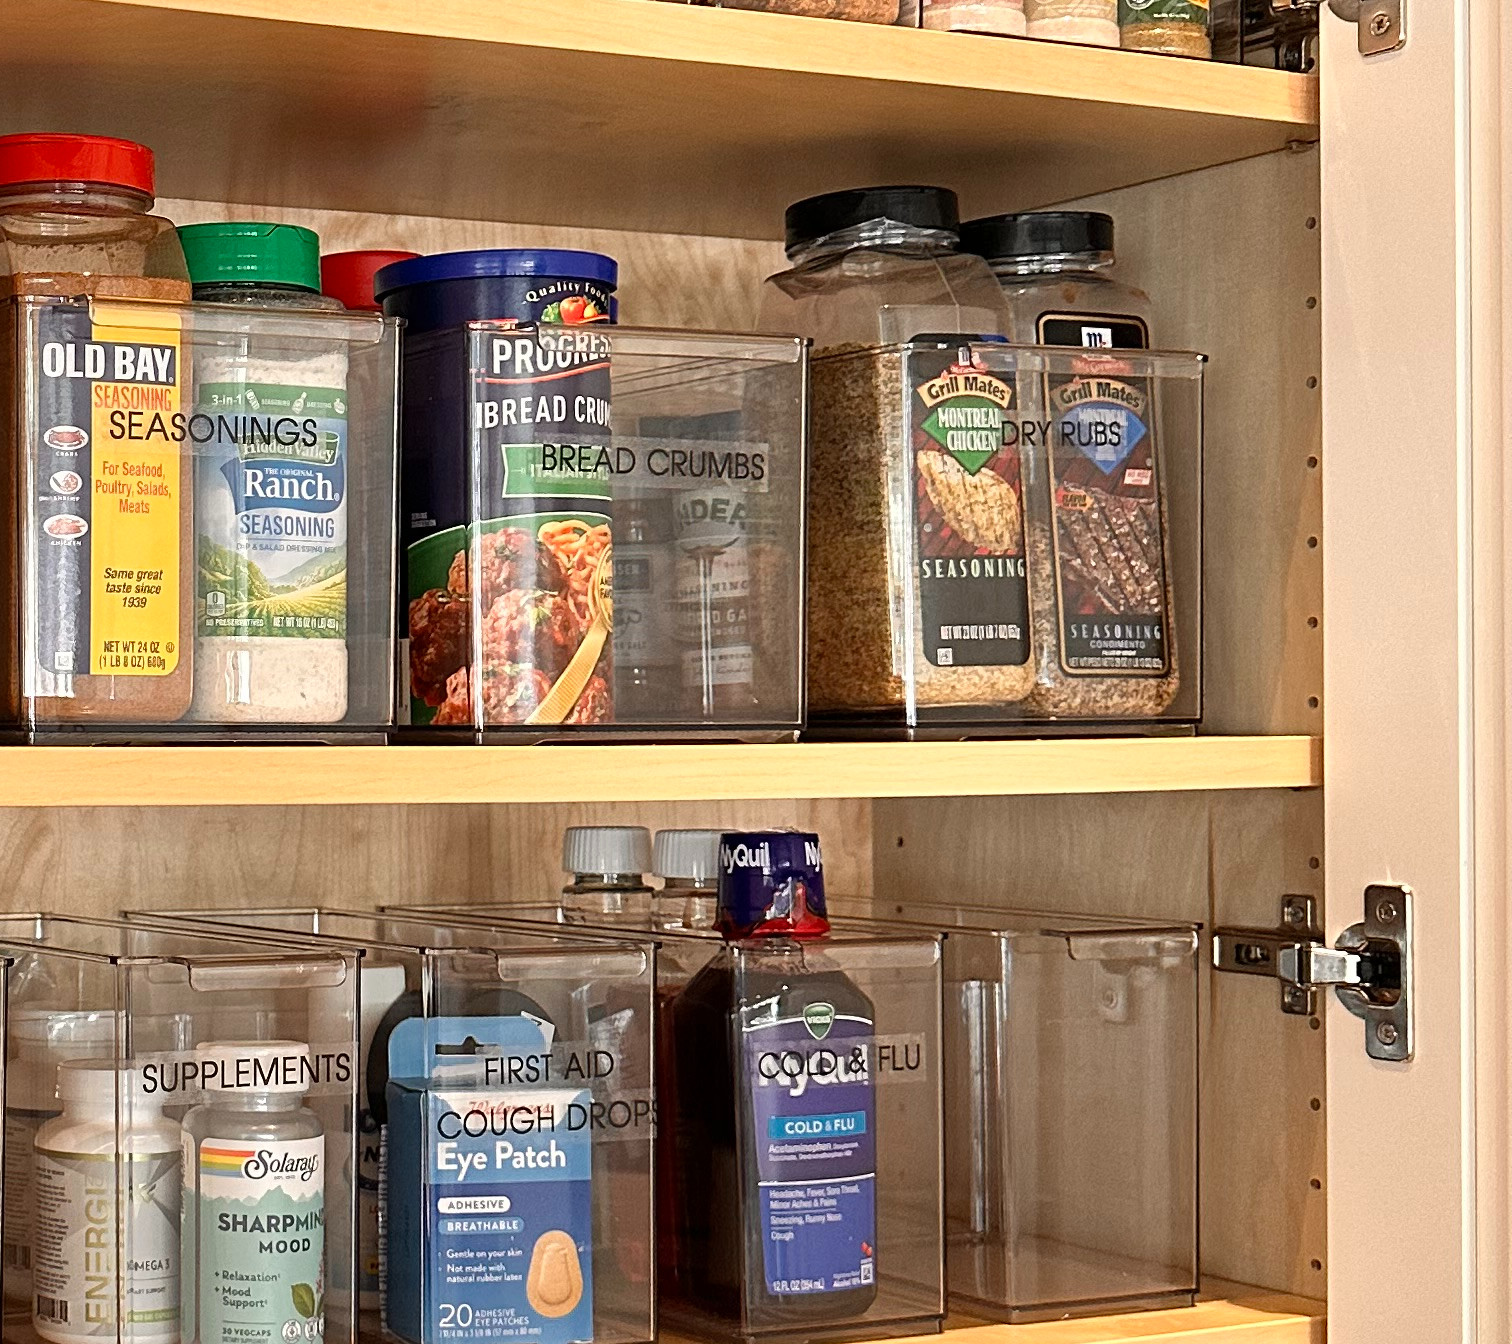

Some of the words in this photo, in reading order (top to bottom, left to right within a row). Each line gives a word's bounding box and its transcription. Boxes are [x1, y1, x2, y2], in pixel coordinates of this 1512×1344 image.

[524, 280, 581, 303] Quality
[43, 342, 105, 378] OLD
[114, 347, 169, 382] BAY
[94, 385, 172, 412] SEASONING
[926, 375, 960, 398] Grill
[963, 377, 1006, 400] Mates
[109, 411, 318, 447] SEASONINGS
[1001, 420, 1052, 446] DRY
[1061, 421, 1121, 446] RUBS
[103, 461, 119, 476] For
[122, 460, 165, 480] Seafood,
[541, 445, 635, 474] BREAD
[647, 449, 765, 480] CRUMBS
[95, 480, 133, 497] Poultry,
[136, 481, 171, 498] Salads,
[244, 469, 334, 500] Ranch
[119, 500, 150, 514] Meats
[240, 515, 334, 539] SEASONING
[104, 568, 133, 581] Same
[137, 569, 163, 582] great
[922, 559, 1025, 578] SEASONING
[106, 582, 132, 593] taste
[135, 583, 161, 595] since
[122, 596, 147, 608] 1939
[1070, 623, 1160, 638] SEASONING
[103, 641, 119, 653] NET
[122, 641, 136, 653] WT
[485, 1054, 553, 1086] FIRST
[564, 1050, 614, 1079] AID
[758, 1049, 837, 1078] COLD
[878, 1043, 921, 1072] FLU
[142, 1053, 350, 1094] SUPPLEMENTS
[437, 1107, 554, 1139] COUGH
[568, 1099, 657, 1132] DROPS
[784, 1120, 822, 1134] COLD
[834, 1117, 855, 1132] FLU
[244, 1150, 318, 1182] Solaray
[438, 1141, 488, 1181] Eye
[496, 1141, 566, 1169] Patch
[447, 1200, 504, 1210] ADHESIVE
[447, 1220, 519, 1232] BREATHABLE
[259, 1237, 310, 1254] MOOD
[447, 1248, 475, 1258] Gentle
[477, 1249, 486, 1258] on
[488, 1248, 507, 1260] your
[508, 1248, 523, 1257] skin
[222, 1286, 251, 1297] Mood
[439, 1303, 472, 1326] 20
